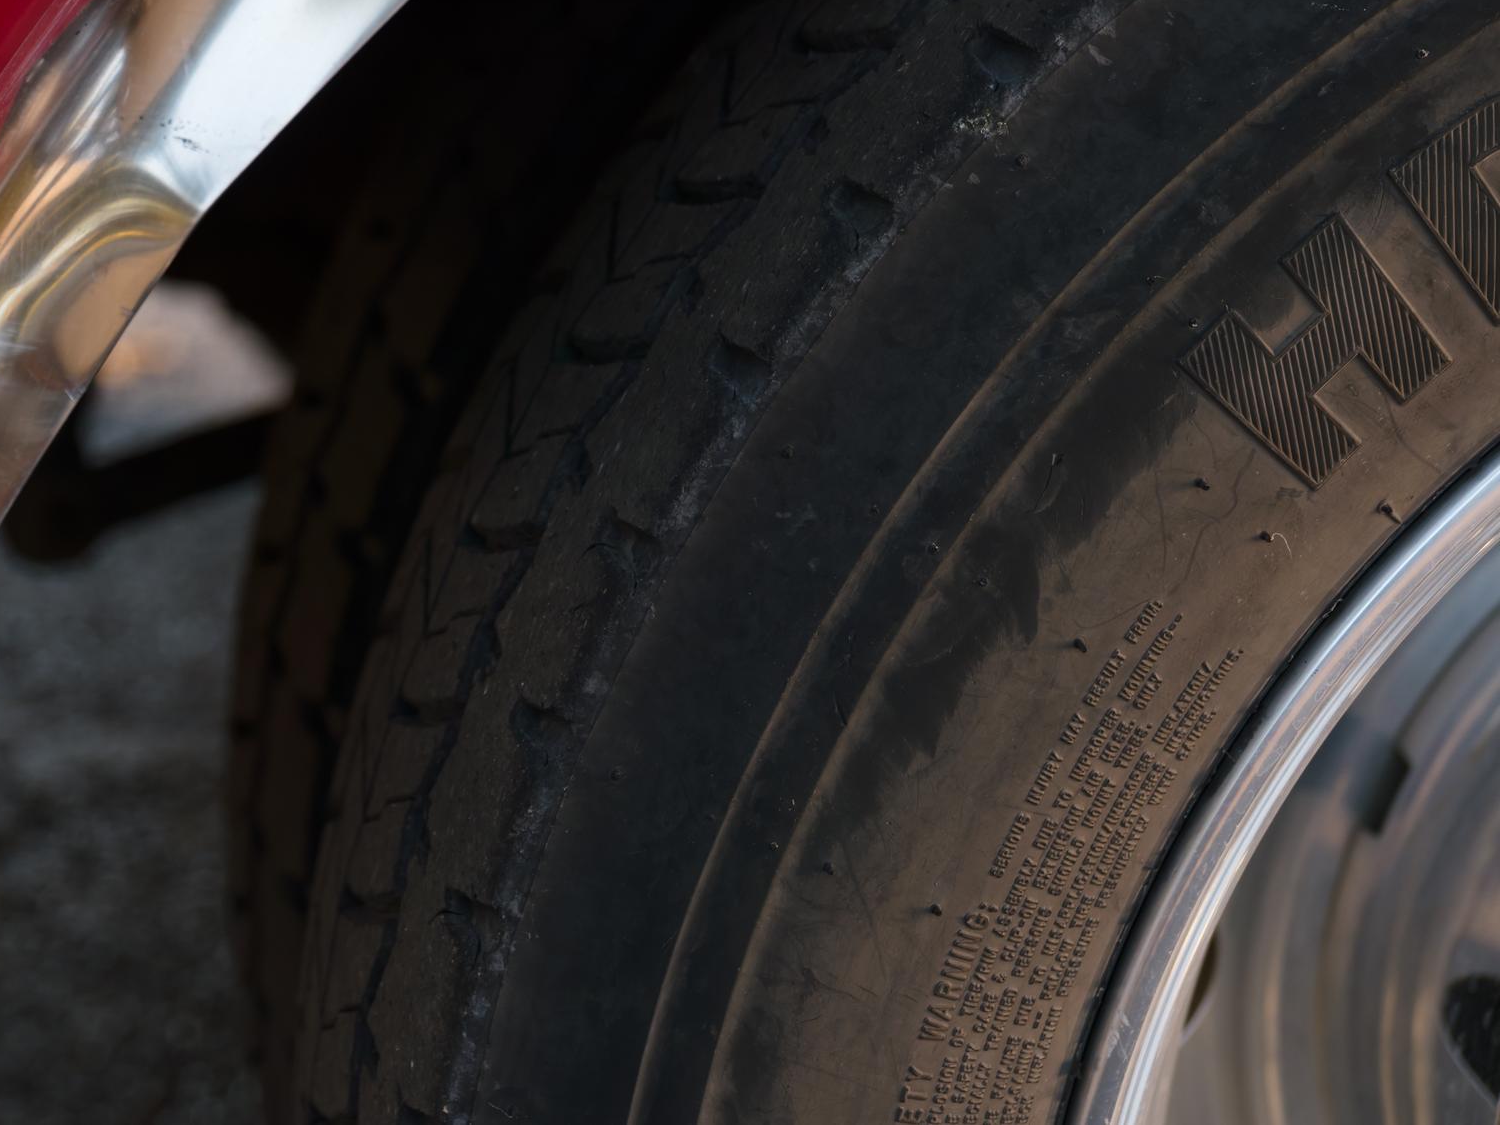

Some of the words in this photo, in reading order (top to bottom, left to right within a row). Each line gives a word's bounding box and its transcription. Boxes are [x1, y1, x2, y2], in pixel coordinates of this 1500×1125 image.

[951, 1027, 969, 1048] OF
[993, 858, 1038, 937] ASSEMBLY
[1033, 819, 1058, 850] DUE
[1053, 790, 1072, 811] TO
[1069, 705, 1121, 781] IMPROPER
[990, 813, 1031, 879] SERIOUS
[1026, 752, 1063, 806] INJURY
[1059, 712, 1086, 745] MAY
[1082, 649, 1126, 707] RESULT
[1149, 768, 1180, 810] WITH
[953, 1045, 981, 1104] SAFETY
[992, 971, 1008, 984] &
[1033, 804, 1085, 890] EXTENSION
[1081, 769, 1104, 796] AIR
[1132, 672, 1163, 710] ONLY
[986, 987, 1019, 1053] TRAINED
[1012, 905, 1054, 979] PERSONS
[1049, 837, 1086, 897] SHOULD
[1082, 778, 1118, 830] MOUNT
[1040, 939, 1075, 1001] FOLLOW
[1070, 893, 1096, 931] TIRE
[991, 1035, 1022, 1100] FAILURE
[1015, 995, 1037, 1027] DUE
[1030, 965, 1048, 988] TO
